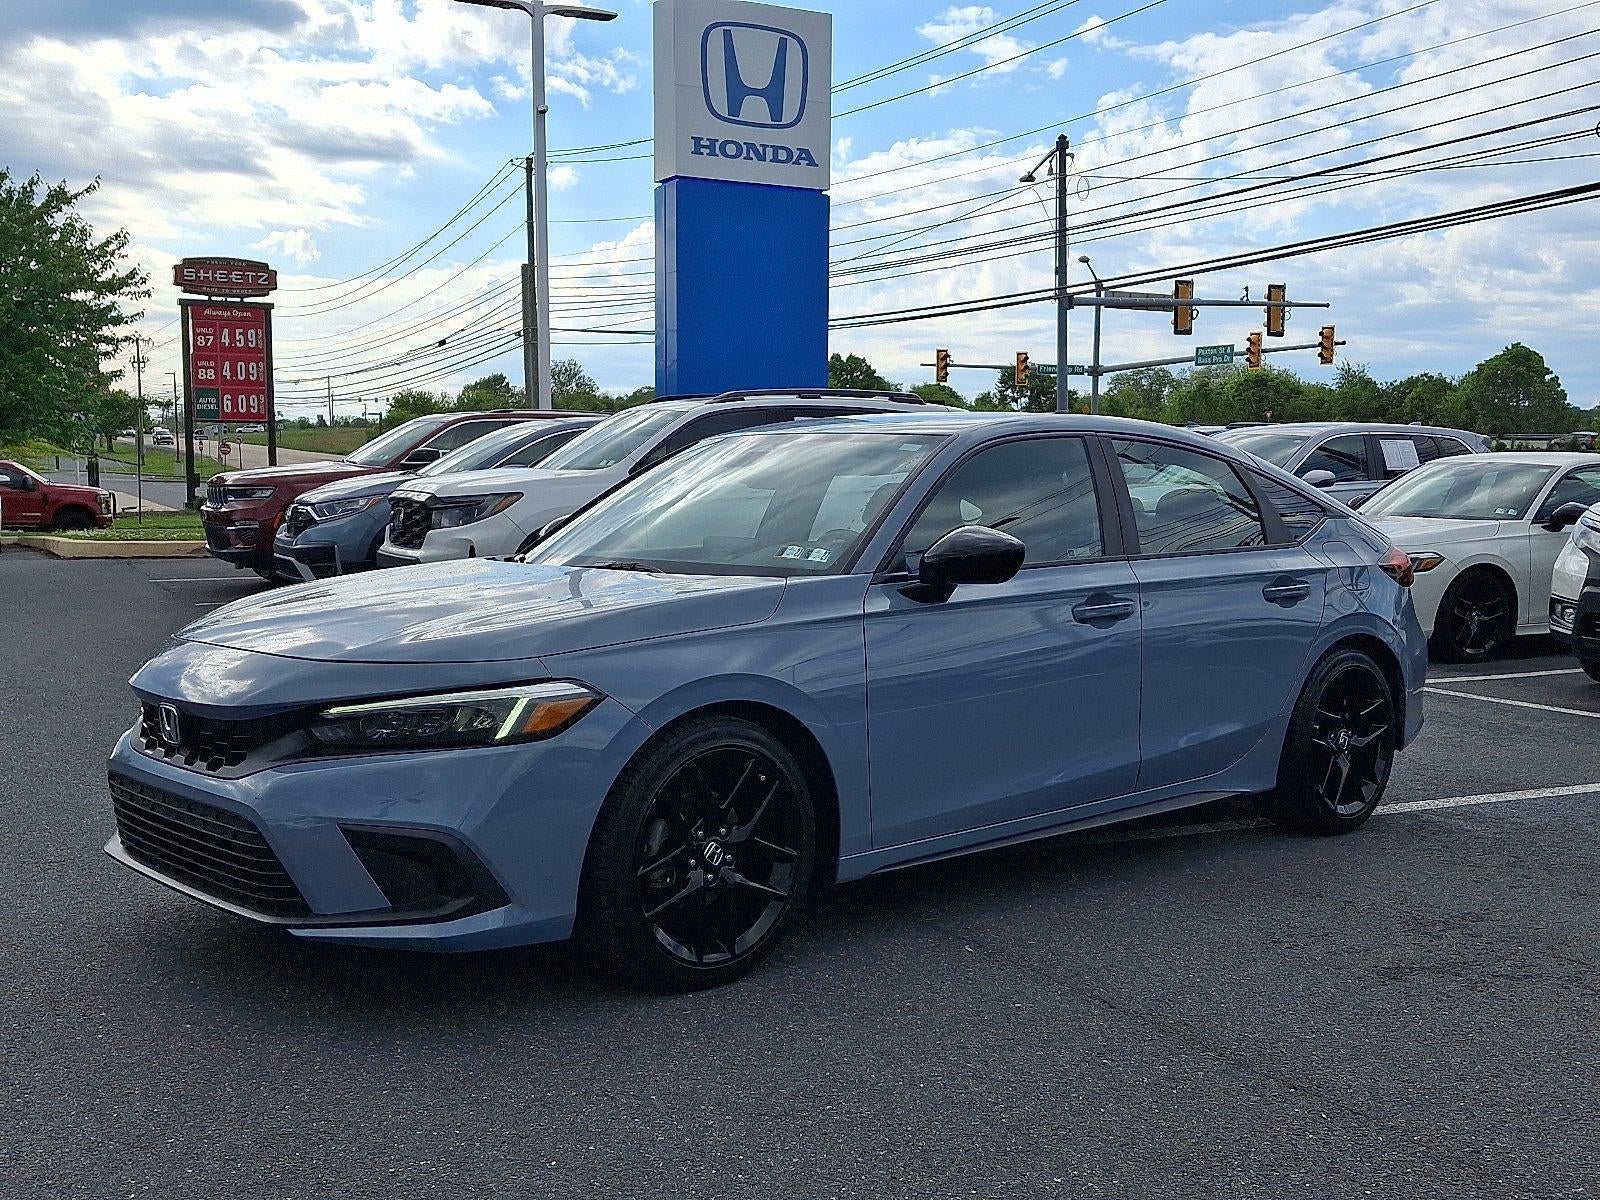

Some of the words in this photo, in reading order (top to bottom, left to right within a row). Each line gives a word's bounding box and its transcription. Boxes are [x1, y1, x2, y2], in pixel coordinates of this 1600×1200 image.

[690, 136, 819, 167] HONDA
[183, 268, 269, 284] SHEETZ
[204, 308, 231, 319] Always
[232, 309, 252, 318] Open
[196, 335, 214, 347] 87
[221, 328, 256, 348] 4.59
[1218, 346, 1225, 354] St
[1212, 355, 1223, 363] Pro
[1223, 354, 1231, 362] Dr
[197, 368, 216, 380] 88
[222, 361, 257, 380] 4.09
[1074, 365, 1083, 373] Rd
[223, 394, 258, 413] 6.09
